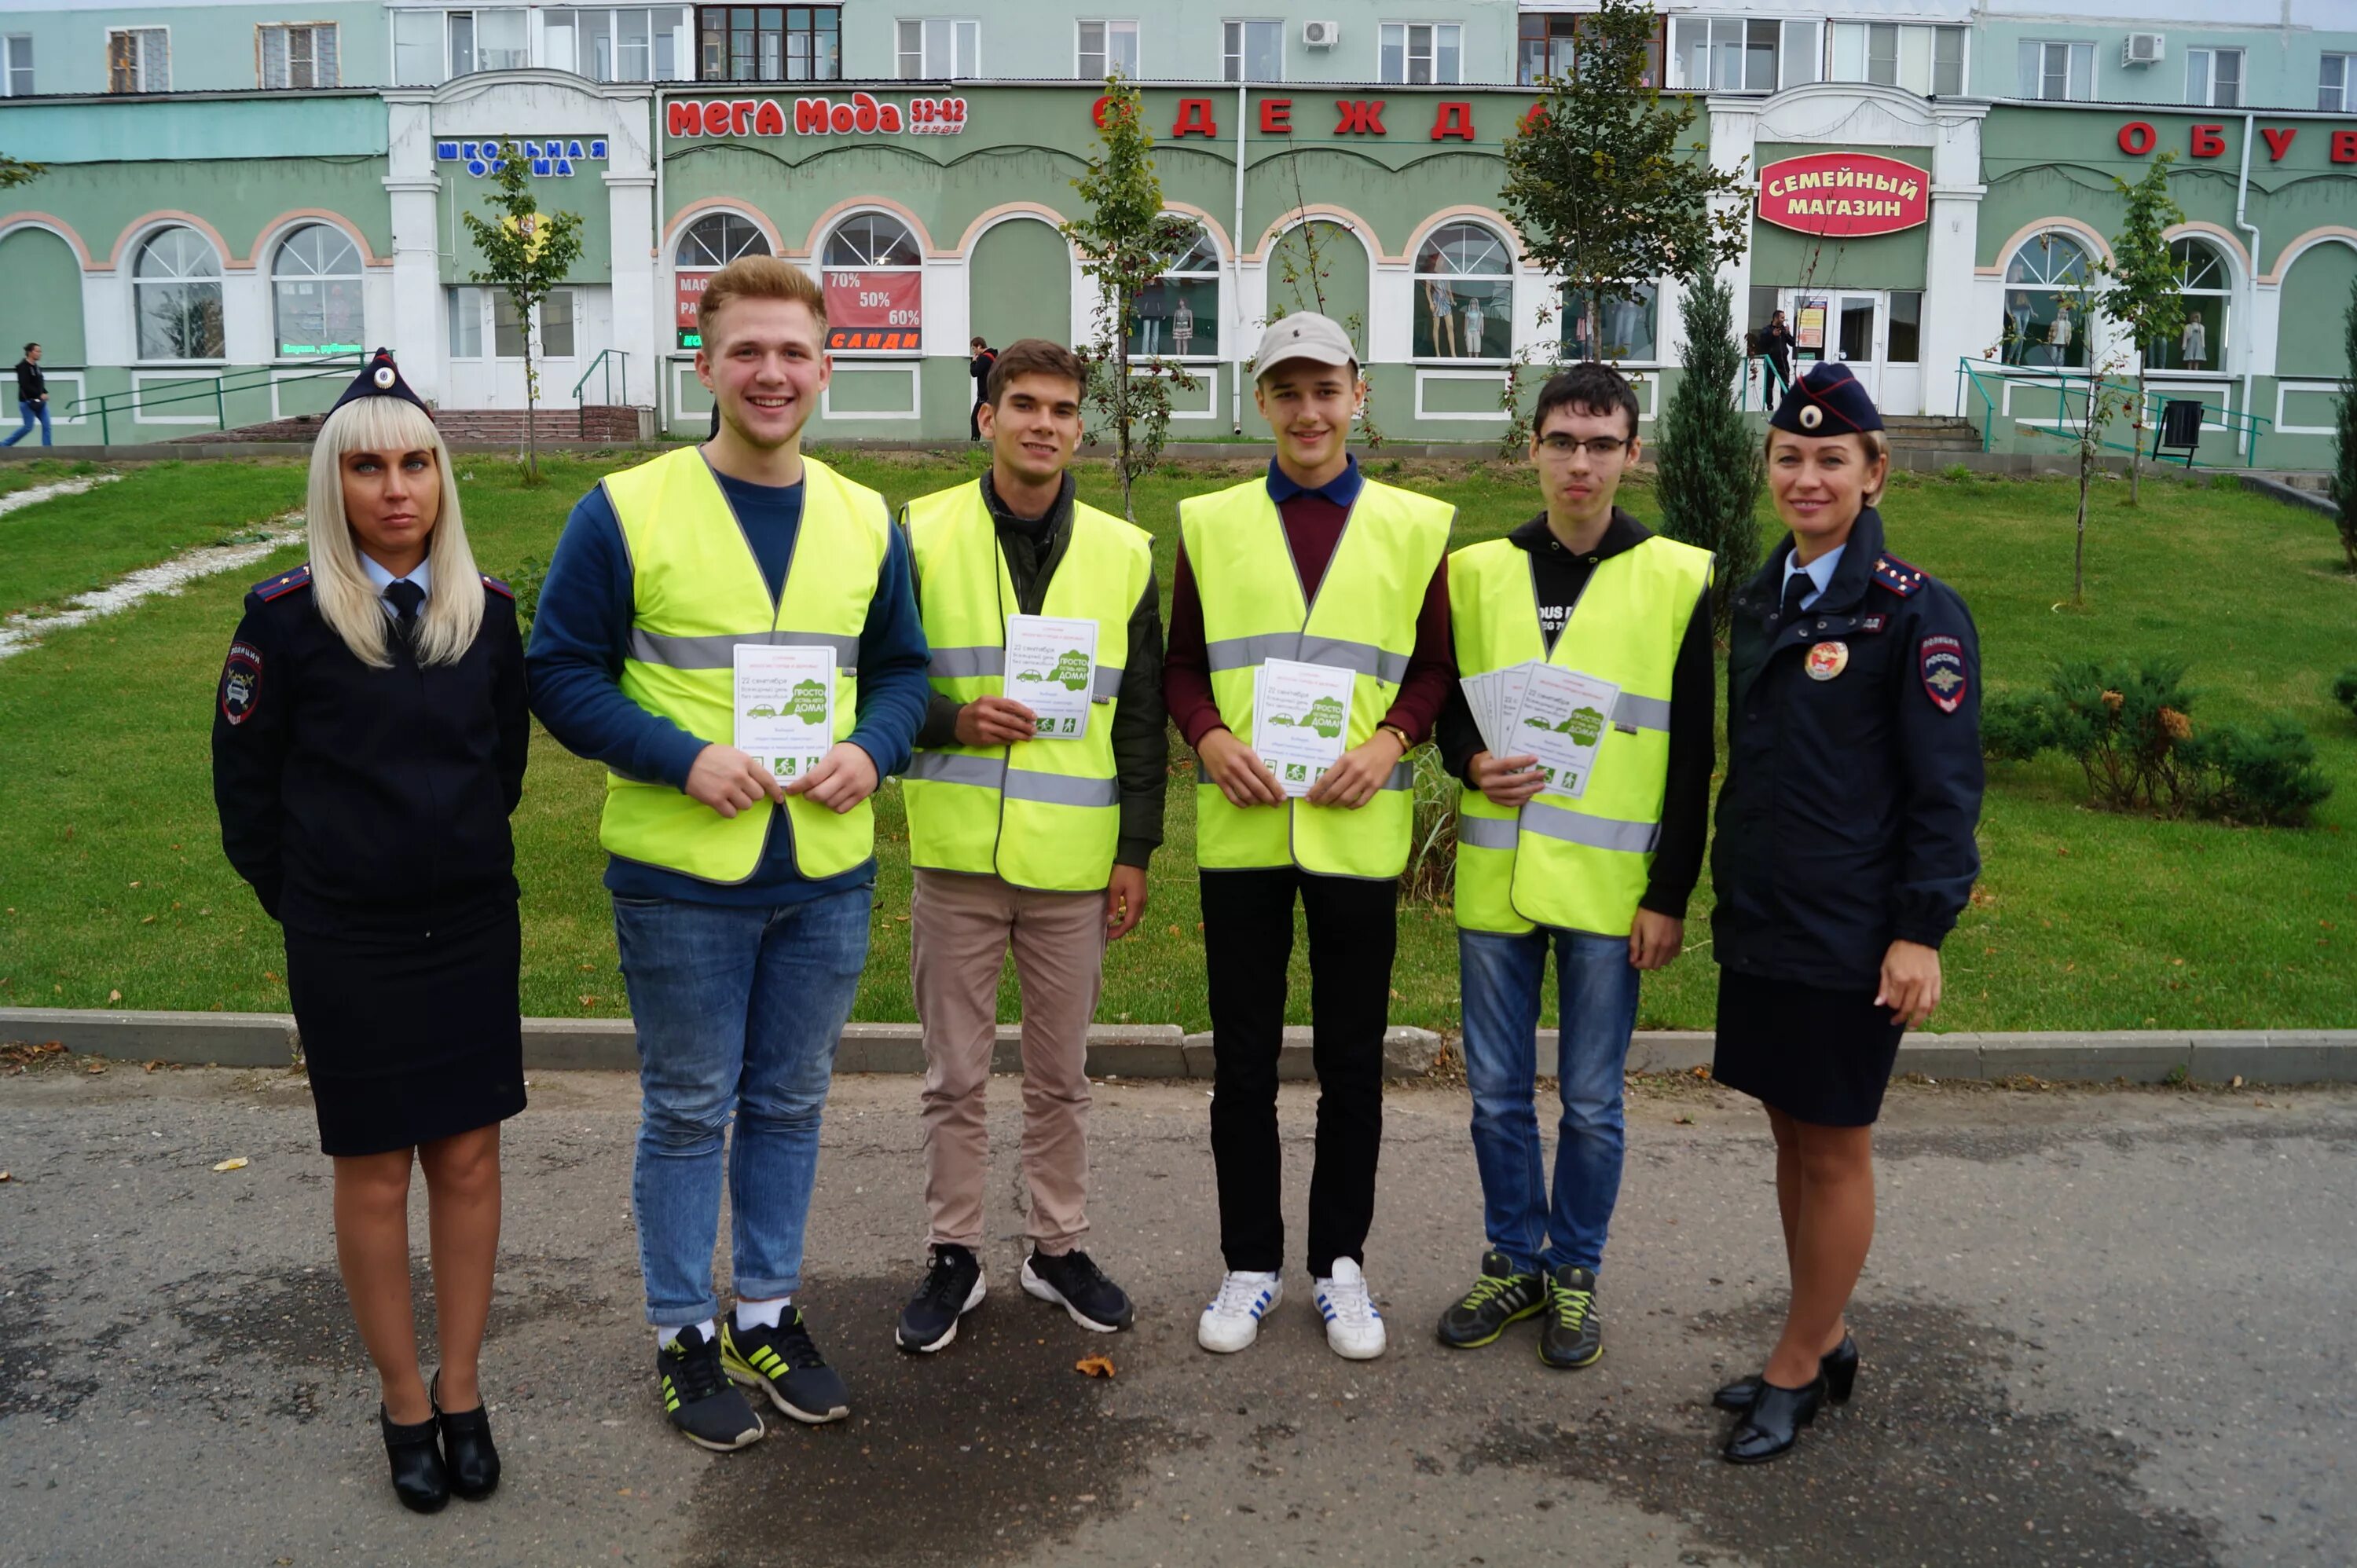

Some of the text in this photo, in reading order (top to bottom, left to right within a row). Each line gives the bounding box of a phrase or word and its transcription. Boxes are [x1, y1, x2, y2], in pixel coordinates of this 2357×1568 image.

[911, 99, 965, 122] 52-82
[467, 159, 573, 176] ФОМА
[1768, 167, 1919, 201] СЕМЕЙНЫЙ
[1787, 198, 1901, 216] МАГАЗИН
[680, 278, 709, 291] МАС
[830, 273, 860, 288] 70%
[860, 291, 890, 307] 50%
[680, 302, 698, 314] РА
[889, 310, 919, 325] 60%
[830, 333, 918, 350] САНДИ
[1060, 658, 1087, 666] ПРОСТО
[752, 677, 787, 686] сентября
[1059, 672, 1087, 680] ДОМА!
